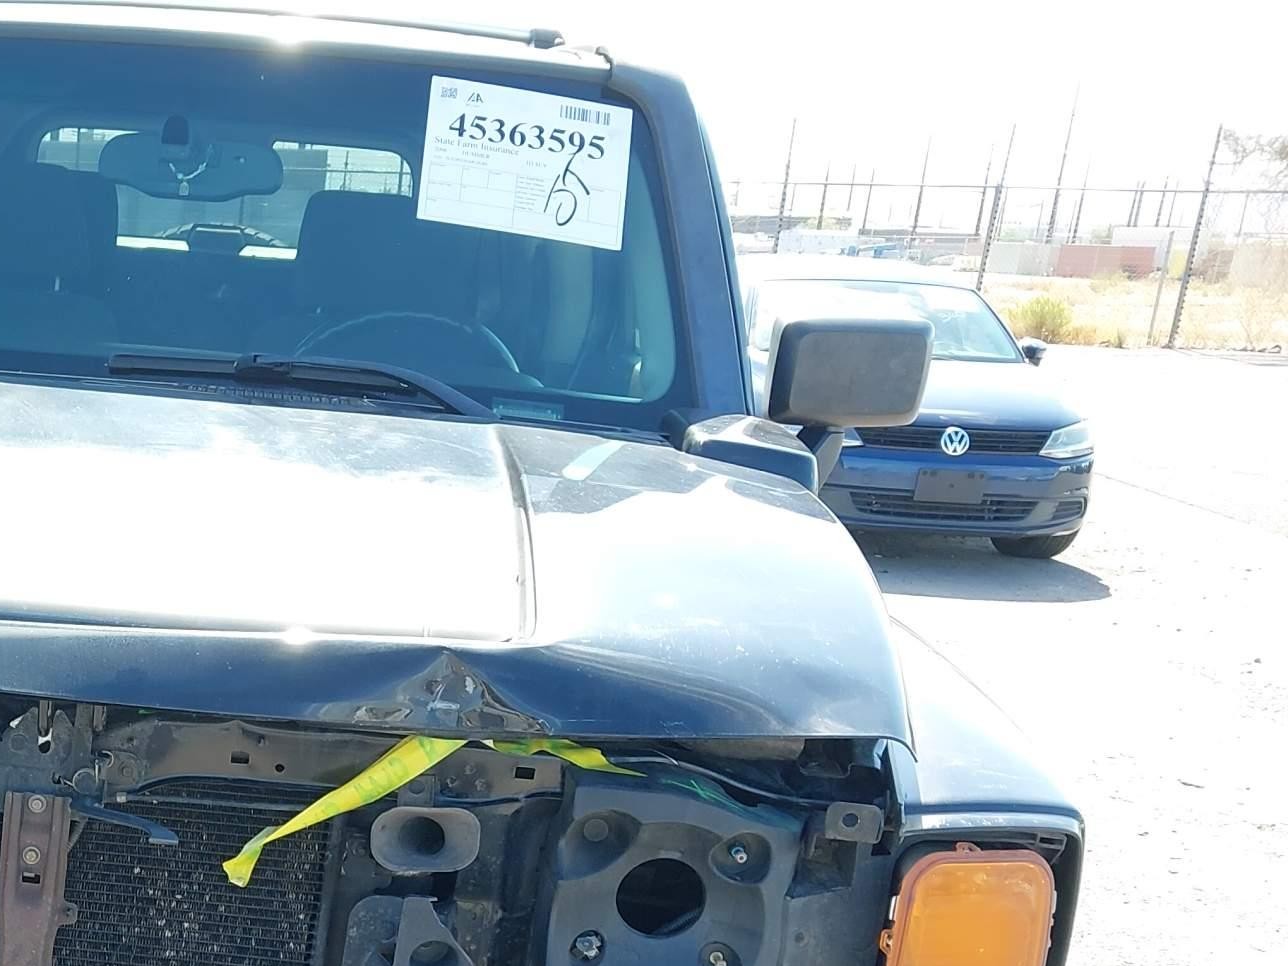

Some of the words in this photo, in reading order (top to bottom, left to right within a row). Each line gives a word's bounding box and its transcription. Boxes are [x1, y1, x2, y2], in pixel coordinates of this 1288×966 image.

[434, 135, 455, 147] State
[457, 138, 478, 150] Farm
[481, 141, 520, 156] Insurance
[448, 113, 606, 160] 45363595
